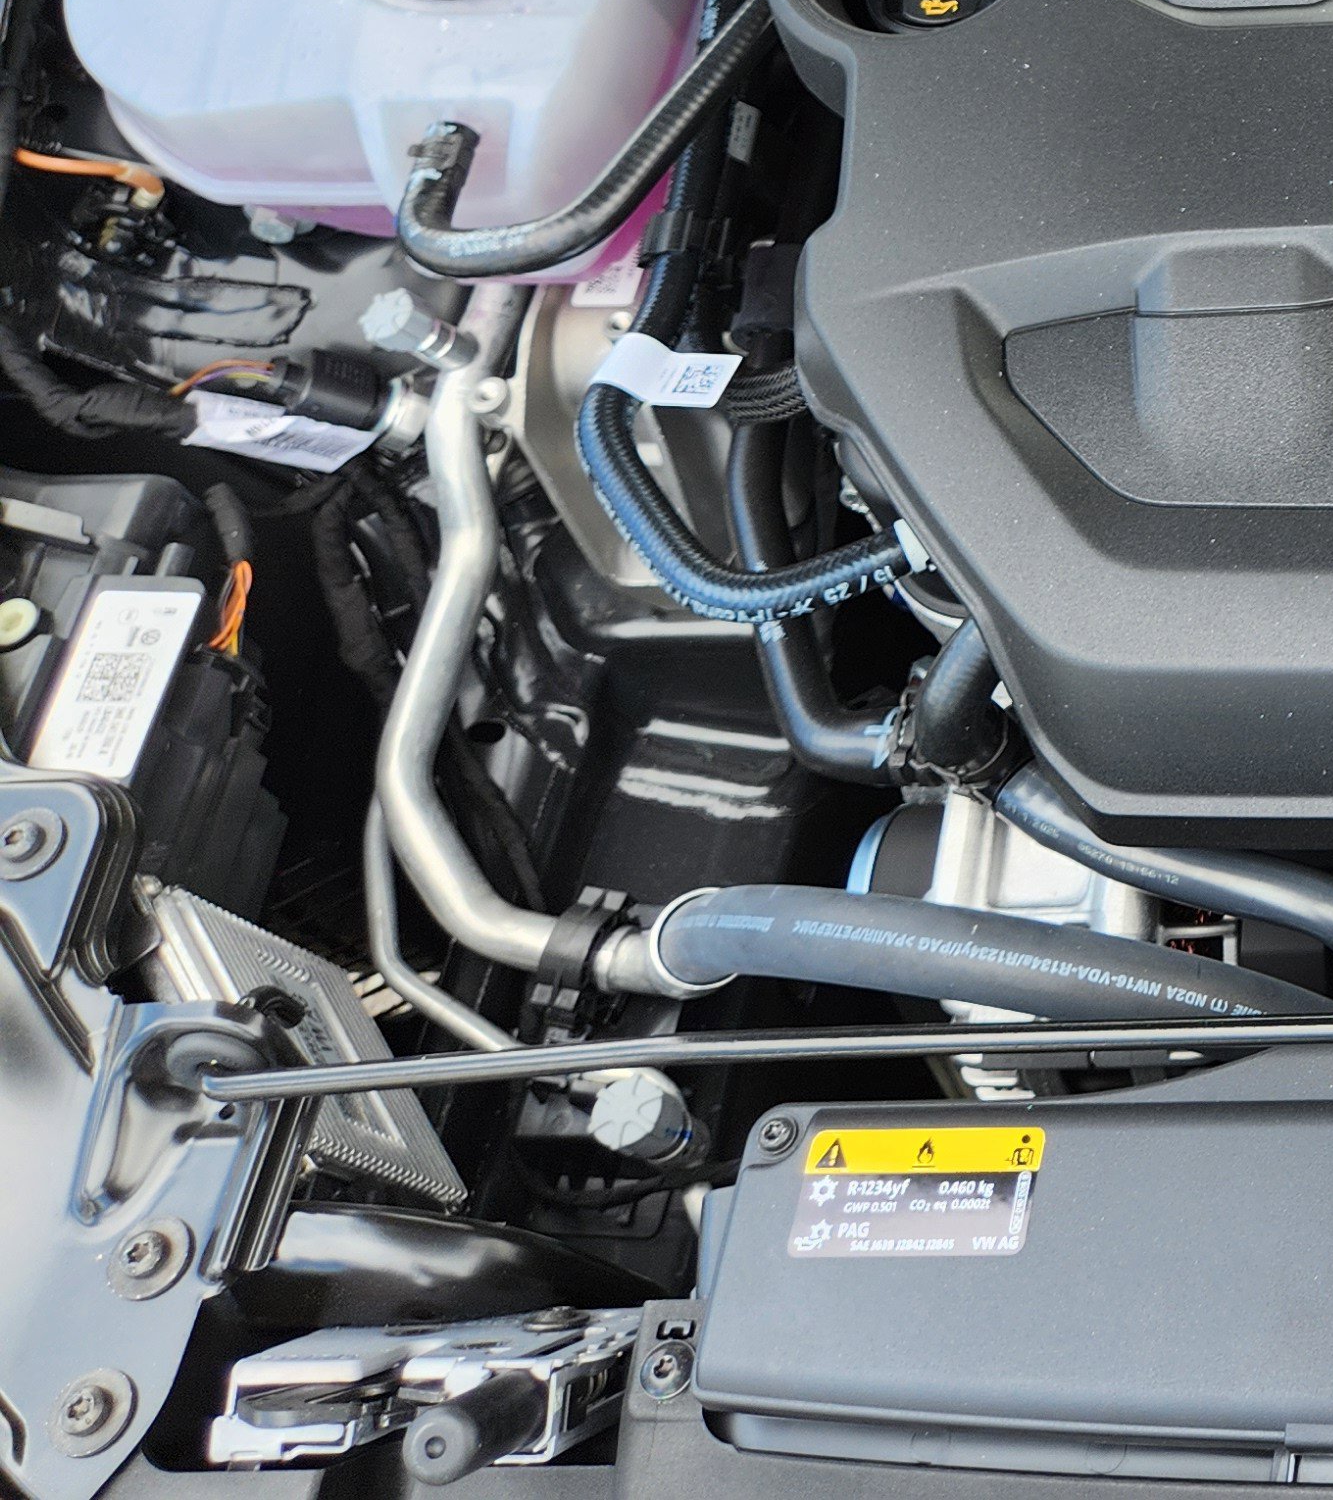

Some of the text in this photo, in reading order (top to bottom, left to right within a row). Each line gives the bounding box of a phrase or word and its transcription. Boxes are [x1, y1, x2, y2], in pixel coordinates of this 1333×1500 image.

[847, 1180, 909, 1198] R-1234yf
[977, 1180, 995, 1198] kg
[838, 1222, 871, 1238] PAG
[972, 1236, 1020, 1250] VW AG
